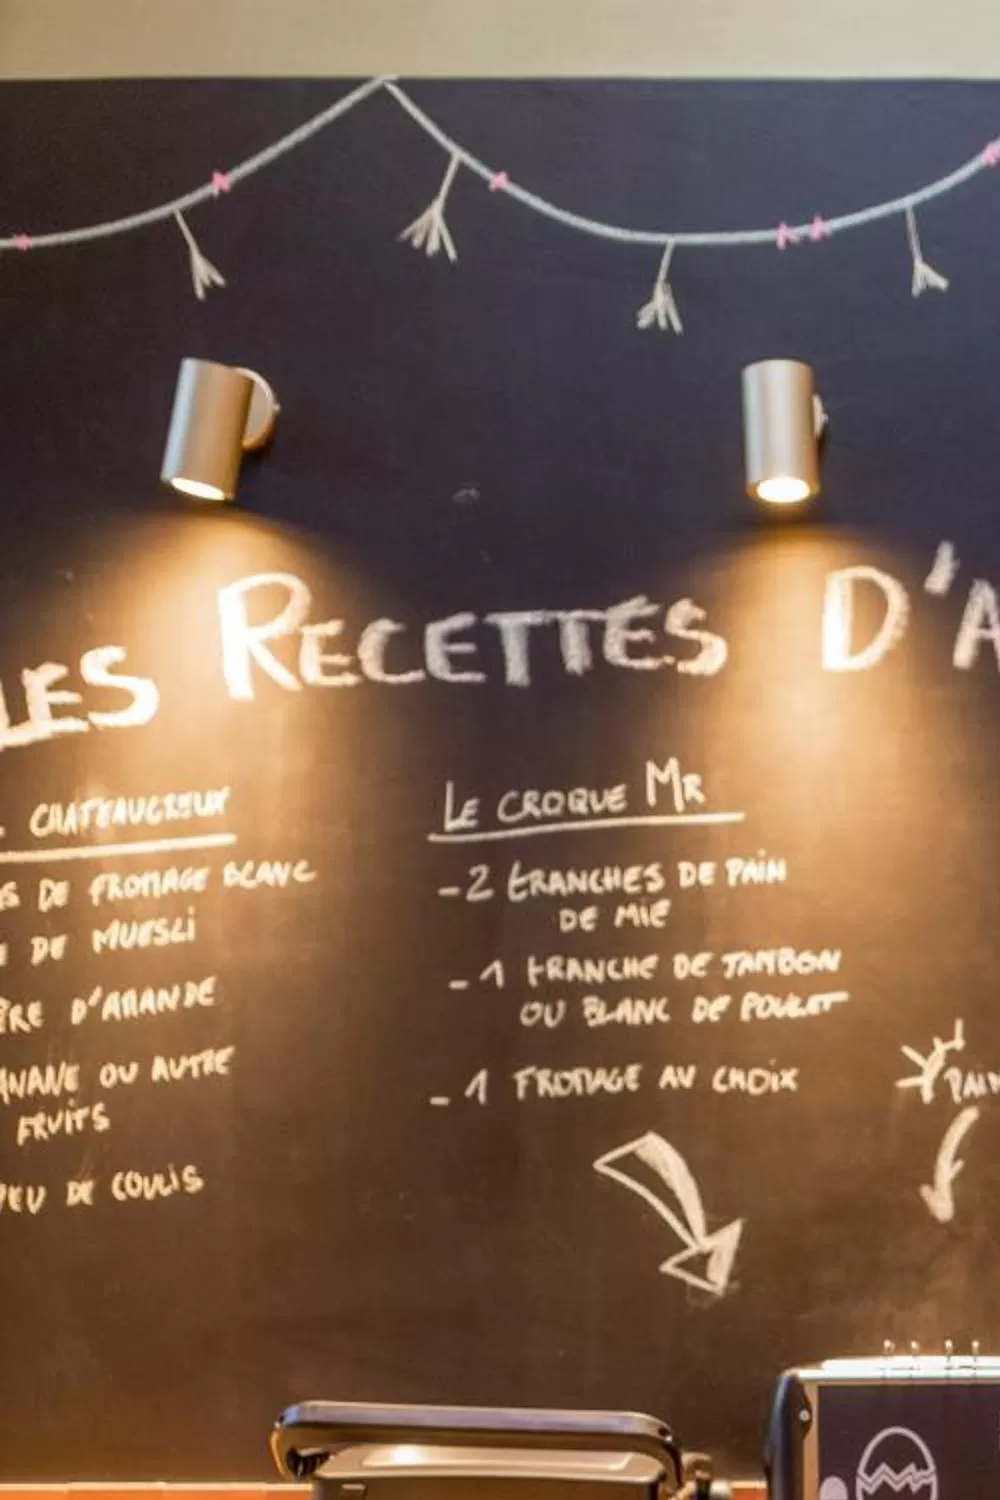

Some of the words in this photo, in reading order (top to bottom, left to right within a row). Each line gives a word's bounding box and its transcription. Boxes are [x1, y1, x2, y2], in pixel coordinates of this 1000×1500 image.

[217, 572, 728, 701] RECETTES
[497, 784, 626, 822] CROQUE
[678, 862, 715, 887] DE
[559, 907, 597, 933] DE
[672, 952, 715, 981] DE
